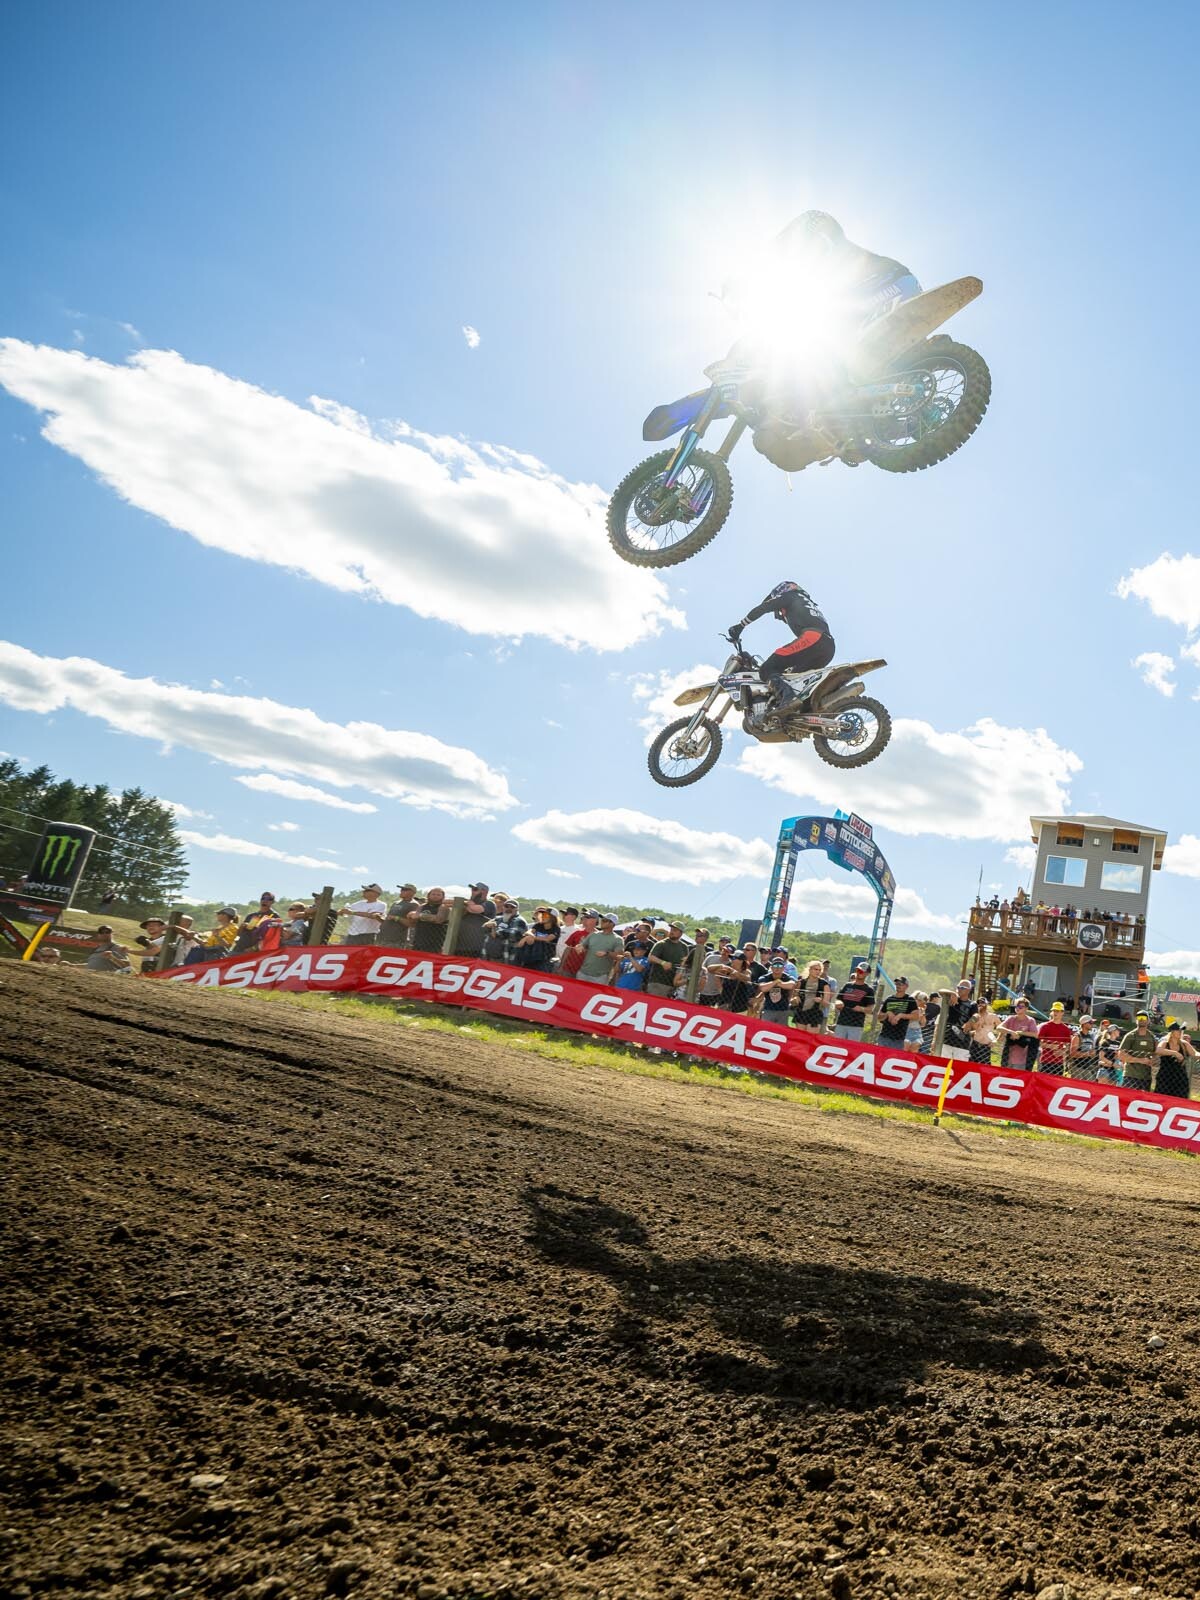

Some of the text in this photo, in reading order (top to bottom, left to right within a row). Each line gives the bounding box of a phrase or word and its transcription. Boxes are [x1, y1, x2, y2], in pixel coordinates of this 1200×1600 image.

[839, 827, 875, 858] MOTOCROSS
[366, 956, 564, 1012] GASGAS
[580, 993, 787, 1062] GASGAS
[805, 1045, 1025, 1109] GASGAS
